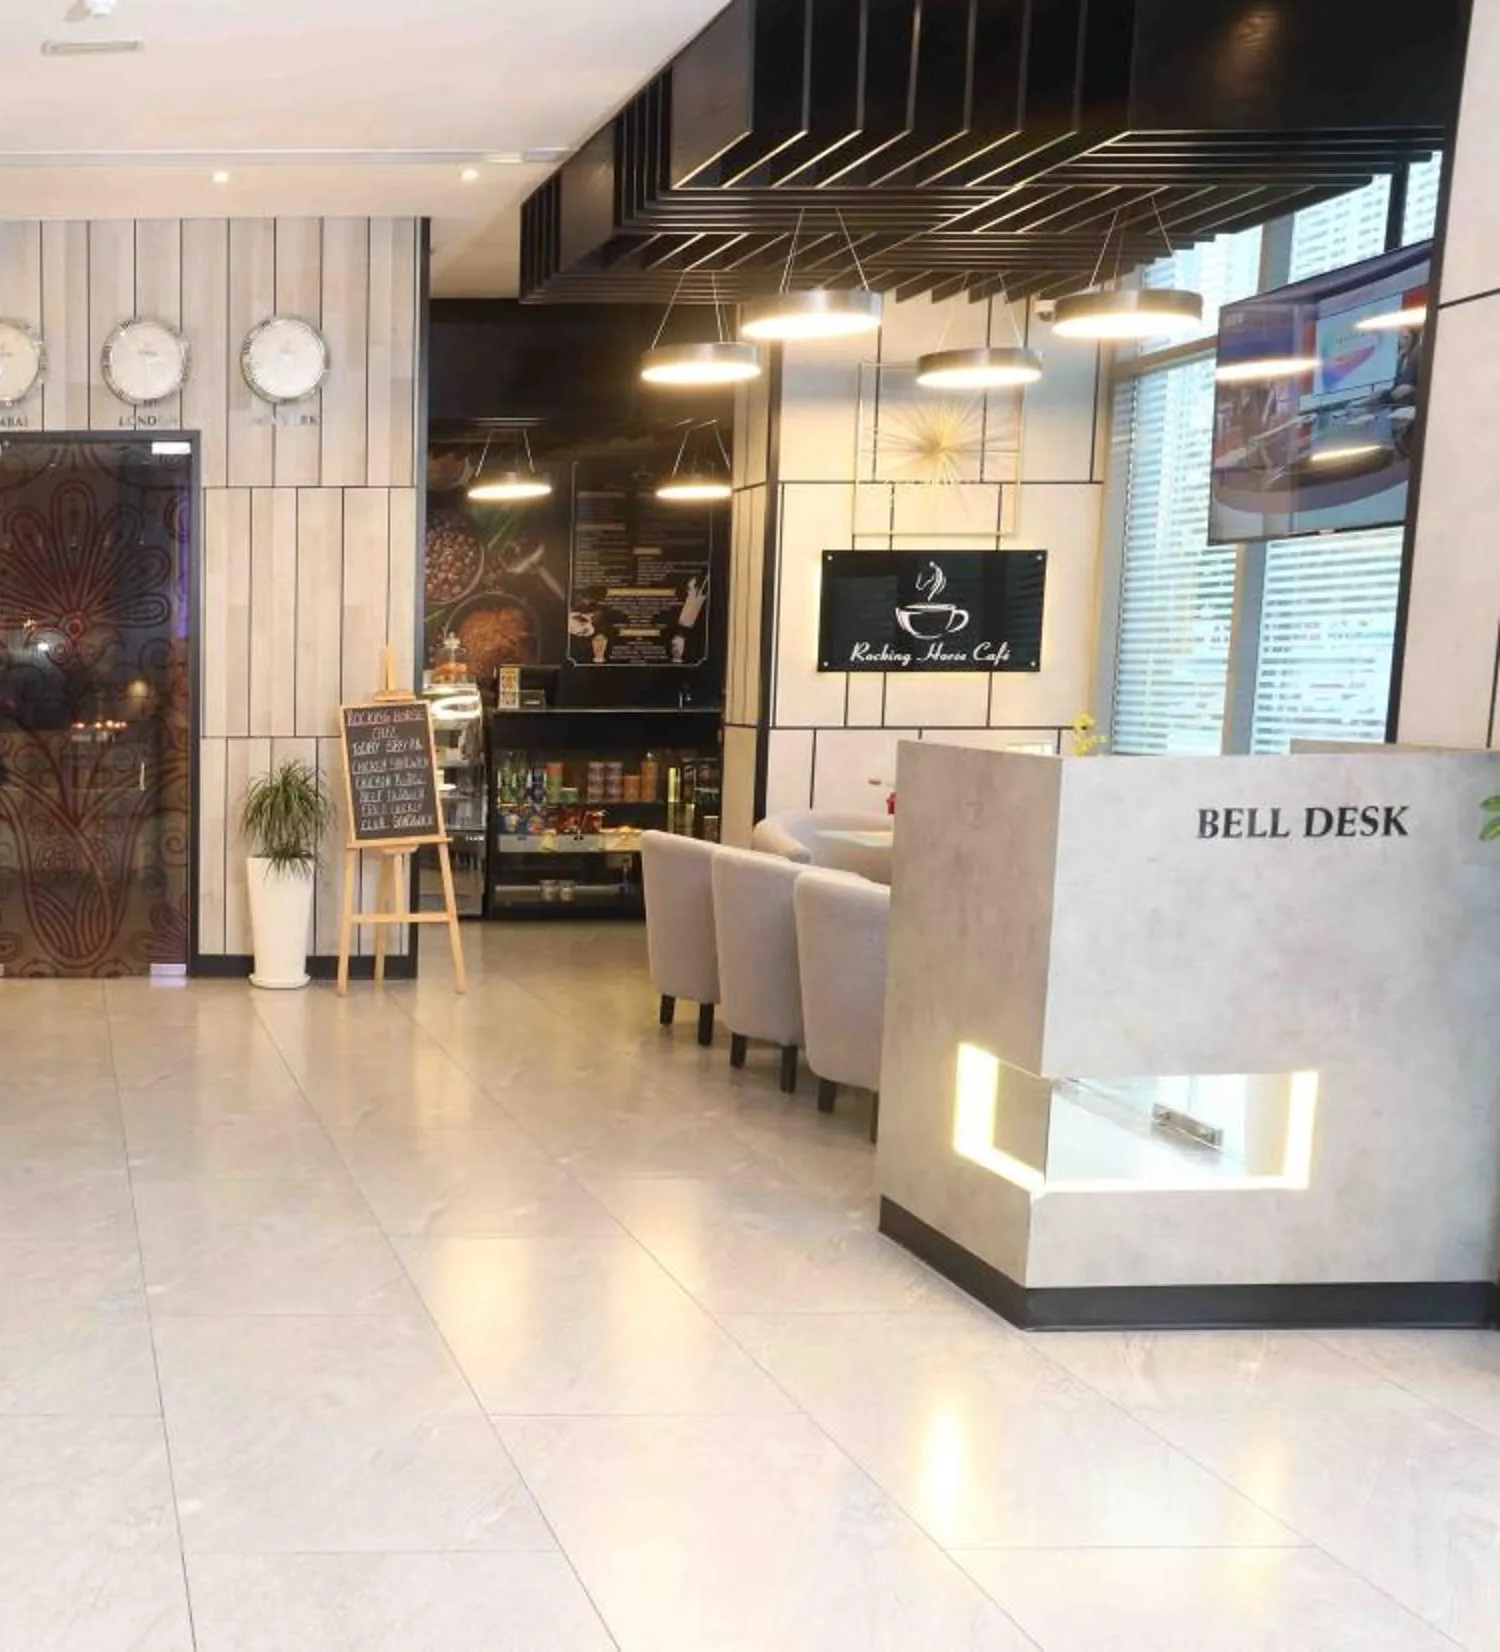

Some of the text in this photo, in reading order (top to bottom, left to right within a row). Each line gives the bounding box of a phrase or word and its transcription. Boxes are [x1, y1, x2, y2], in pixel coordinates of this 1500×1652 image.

[850, 641, 912, 666] Rocking
[916, 641, 967, 662] Horse
[1196, 804, 1411, 839] BELL DESK
